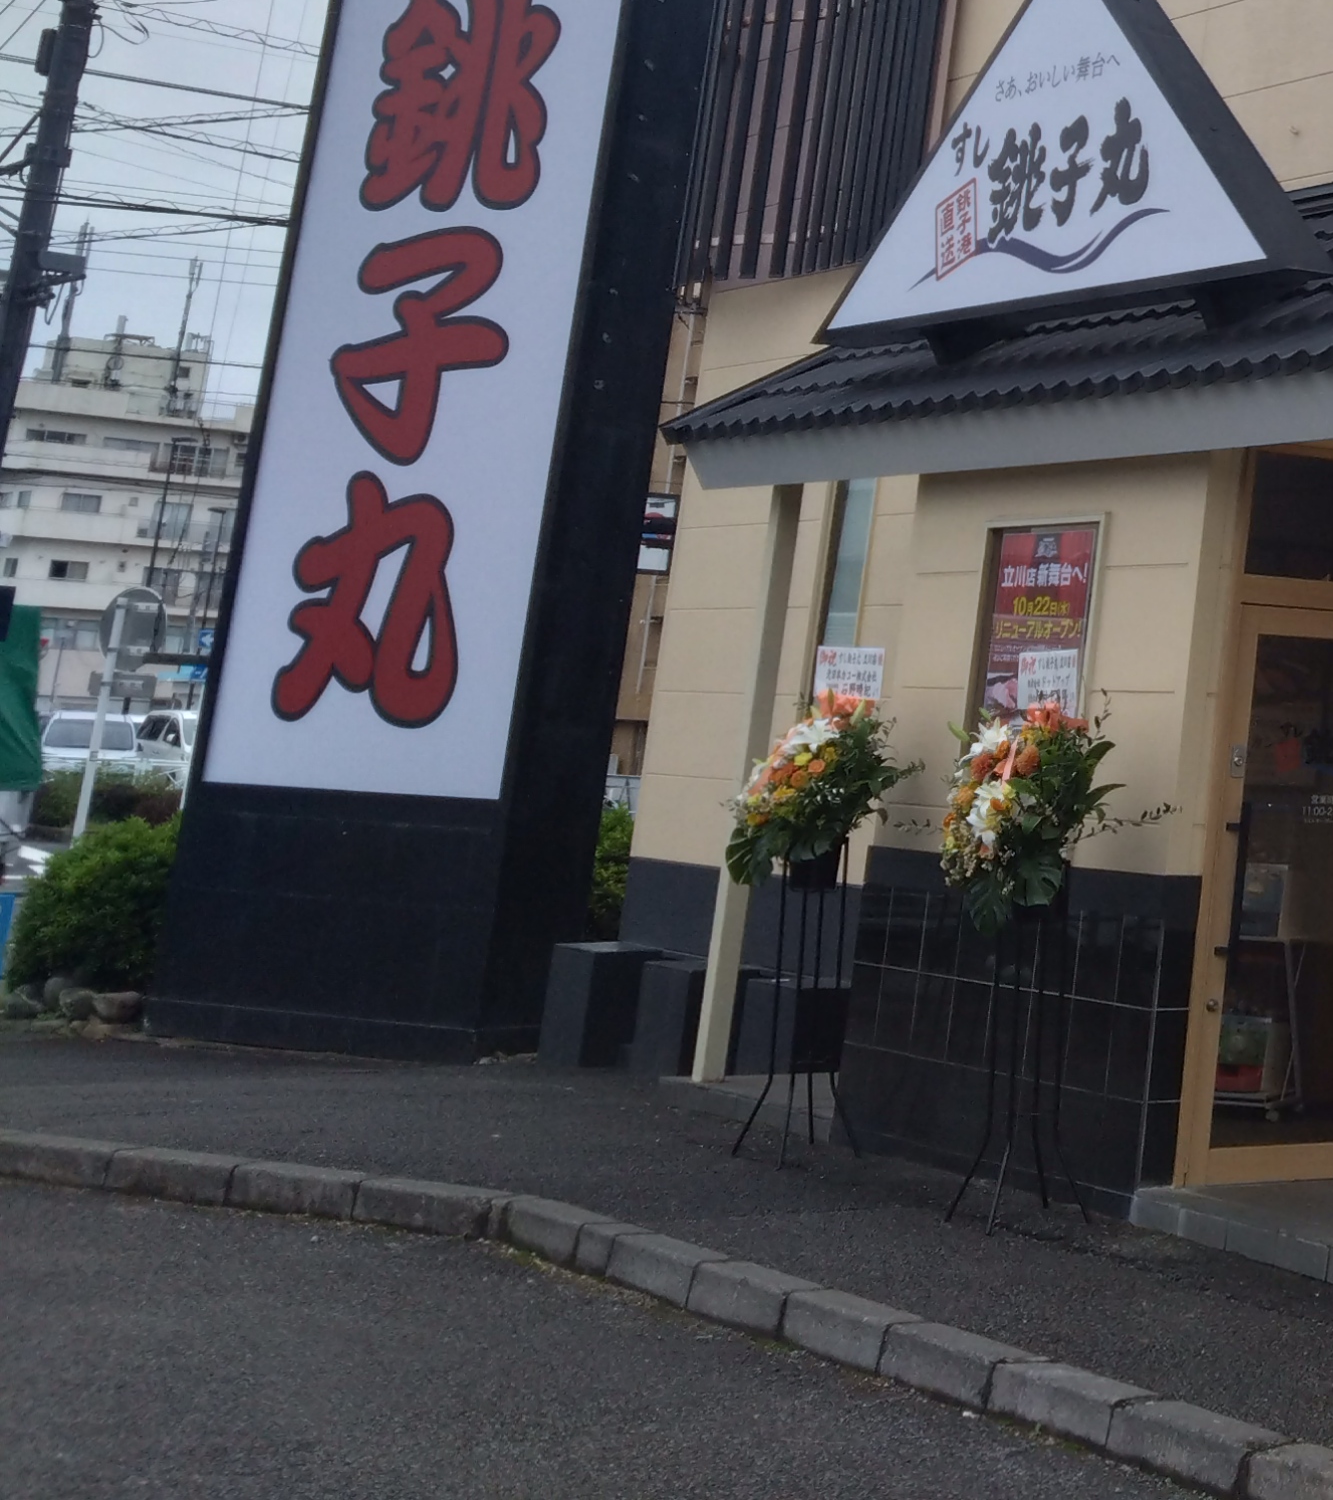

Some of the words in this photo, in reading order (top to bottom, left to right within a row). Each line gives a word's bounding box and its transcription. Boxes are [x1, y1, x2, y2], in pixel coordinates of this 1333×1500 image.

[951, 122, 989, 177] すし
[988, 97, 1149, 248] 銚子丸
[940, 201, 956, 270] 直送
[956, 188, 972, 260] 銚子港
